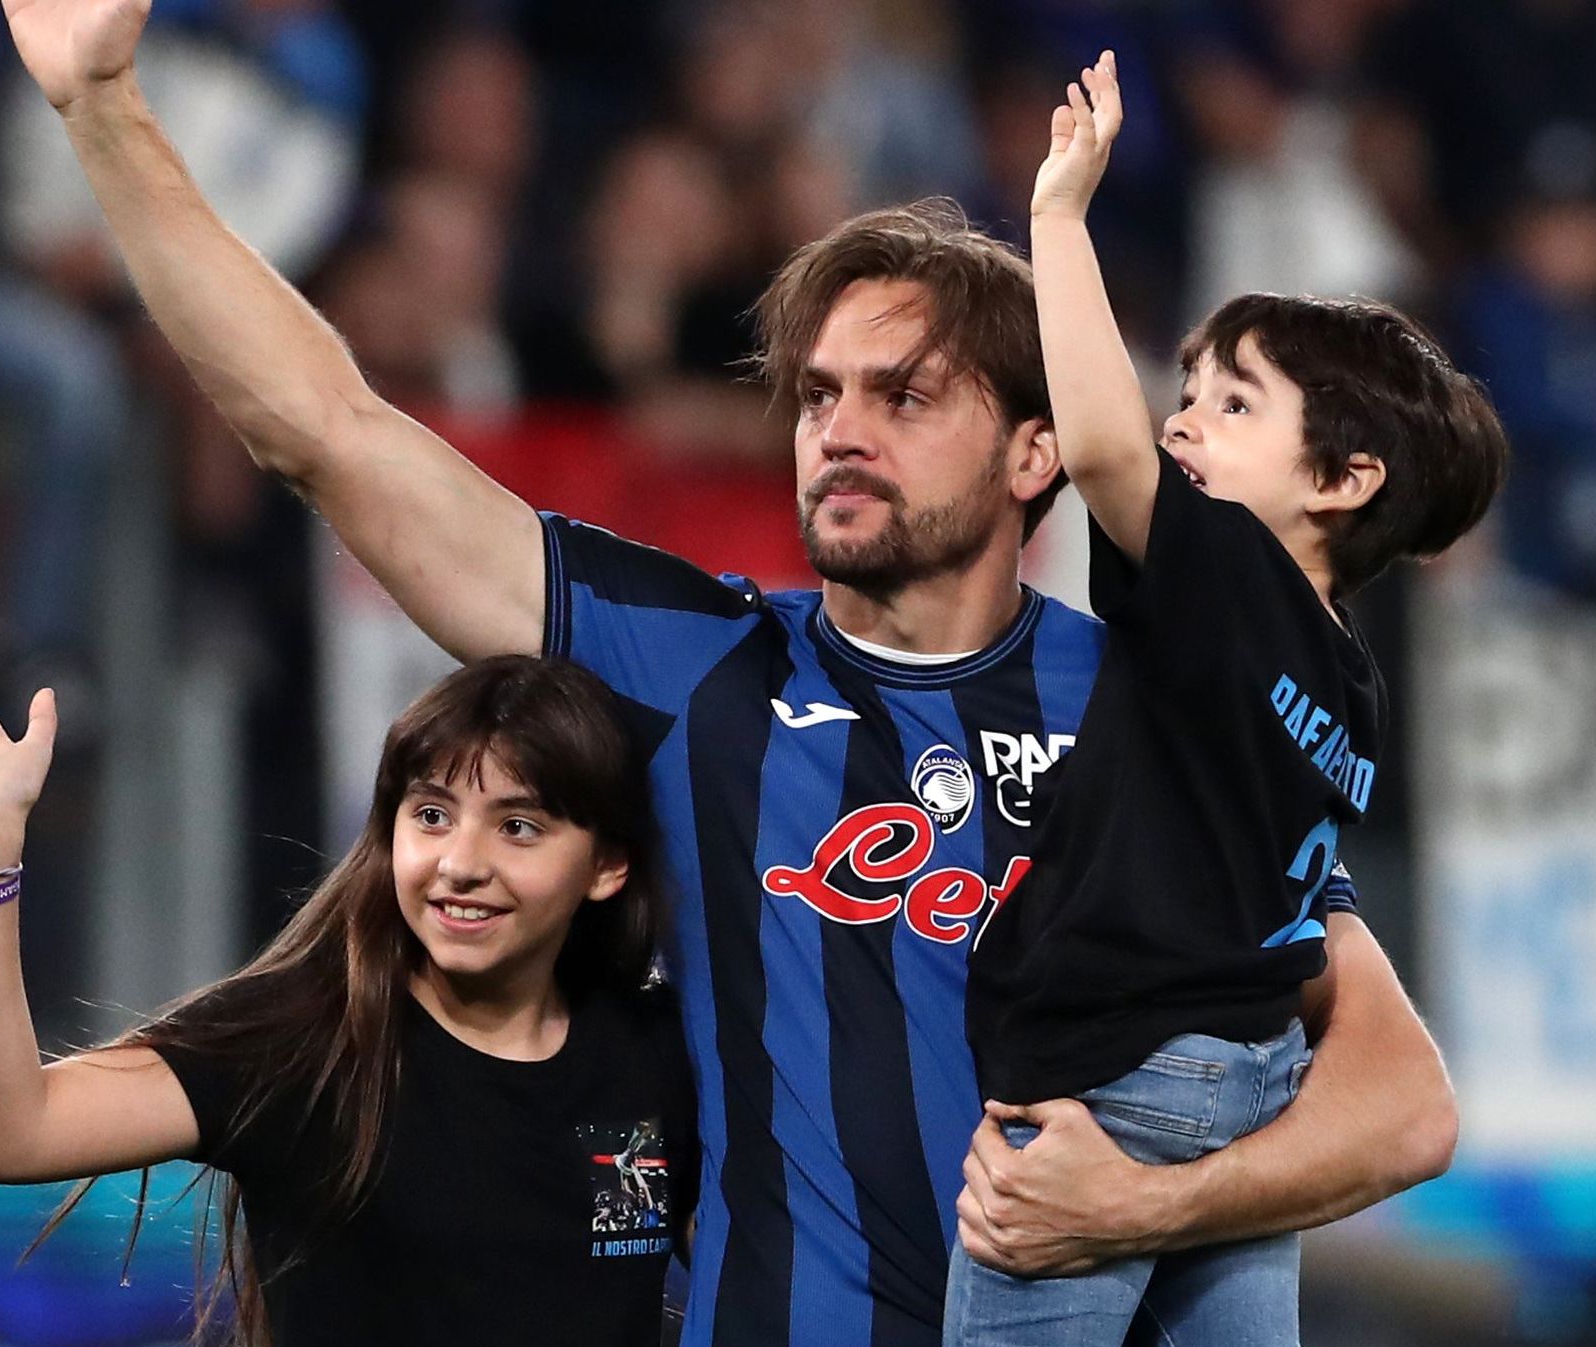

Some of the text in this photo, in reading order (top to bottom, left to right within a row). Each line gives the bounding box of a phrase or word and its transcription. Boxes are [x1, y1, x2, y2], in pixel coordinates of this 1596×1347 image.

[921, 757, 965, 770] ATALANTA
[930, 812, 955, 823] 907
[591, 1241, 602, 1257] IL
[604, 1239, 648, 1257] NOSTRO
